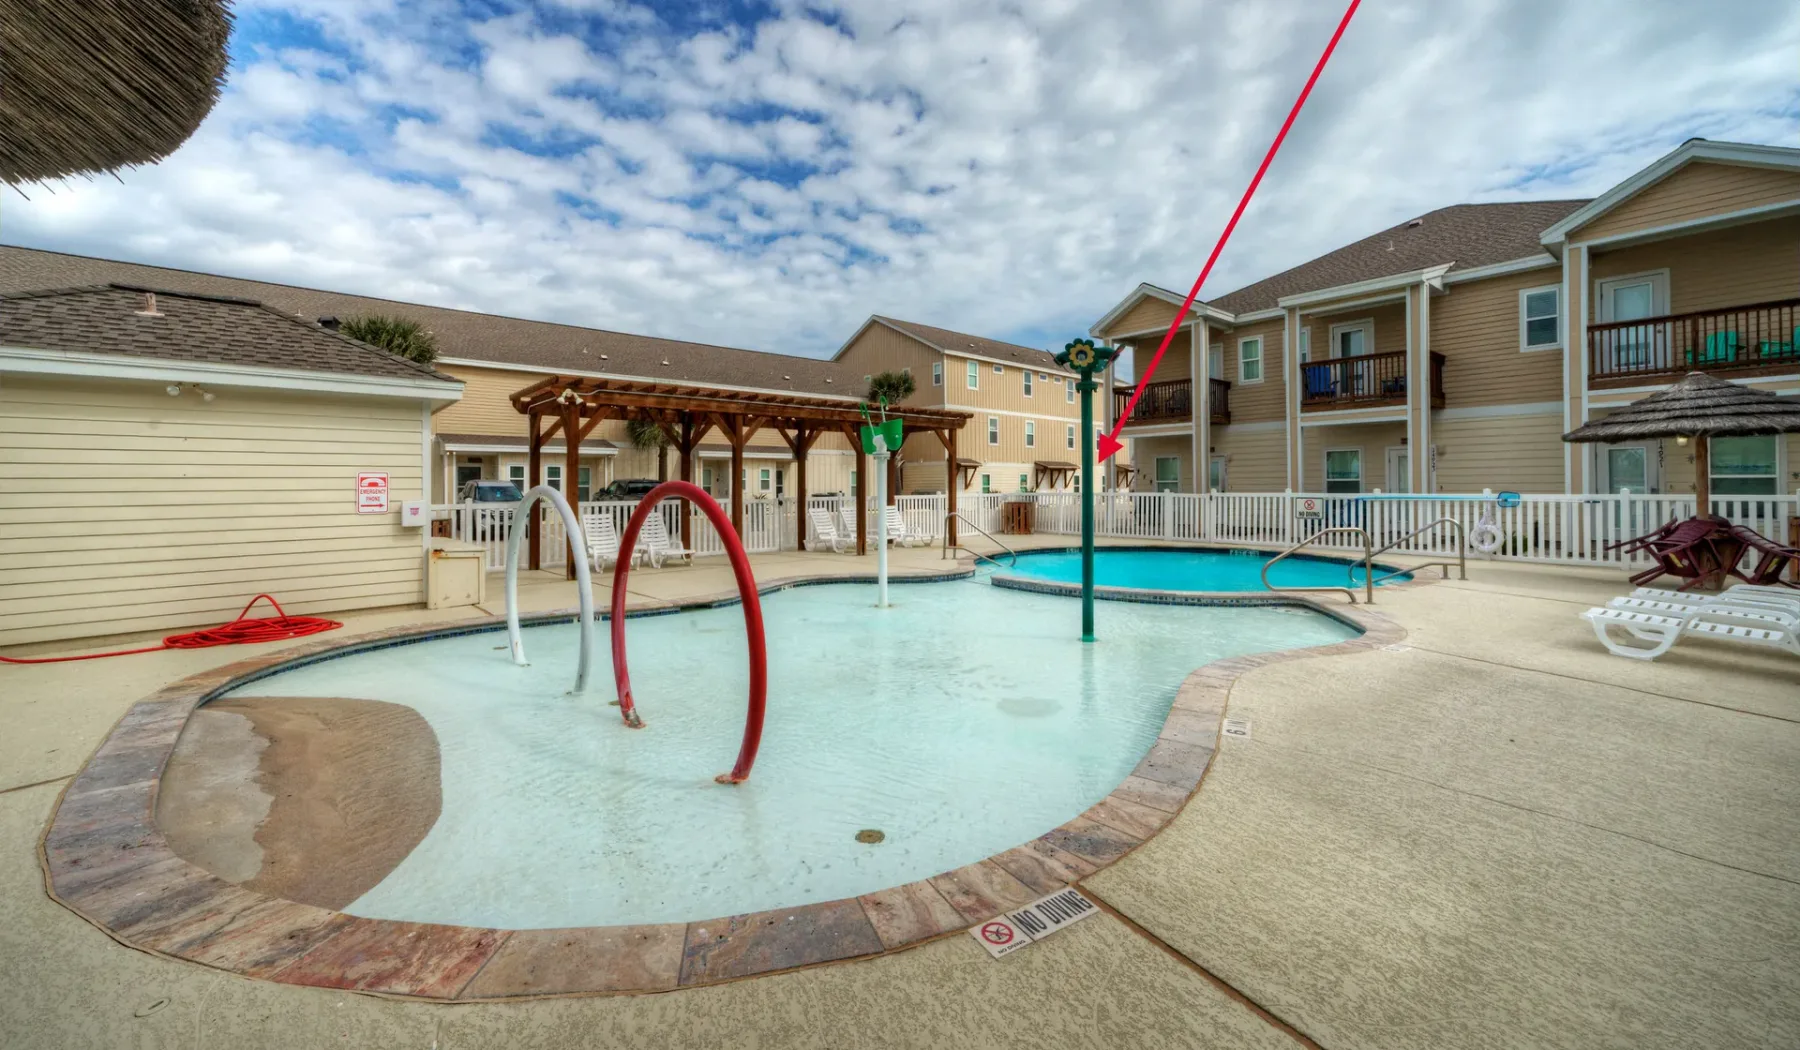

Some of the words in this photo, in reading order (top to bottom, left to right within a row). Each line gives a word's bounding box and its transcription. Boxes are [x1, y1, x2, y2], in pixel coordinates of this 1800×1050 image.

[1012, 910, 1047, 935] NO
[1035, 890, 1094, 925] DIVING
[1008, 939, 1026, 951] DIVING
